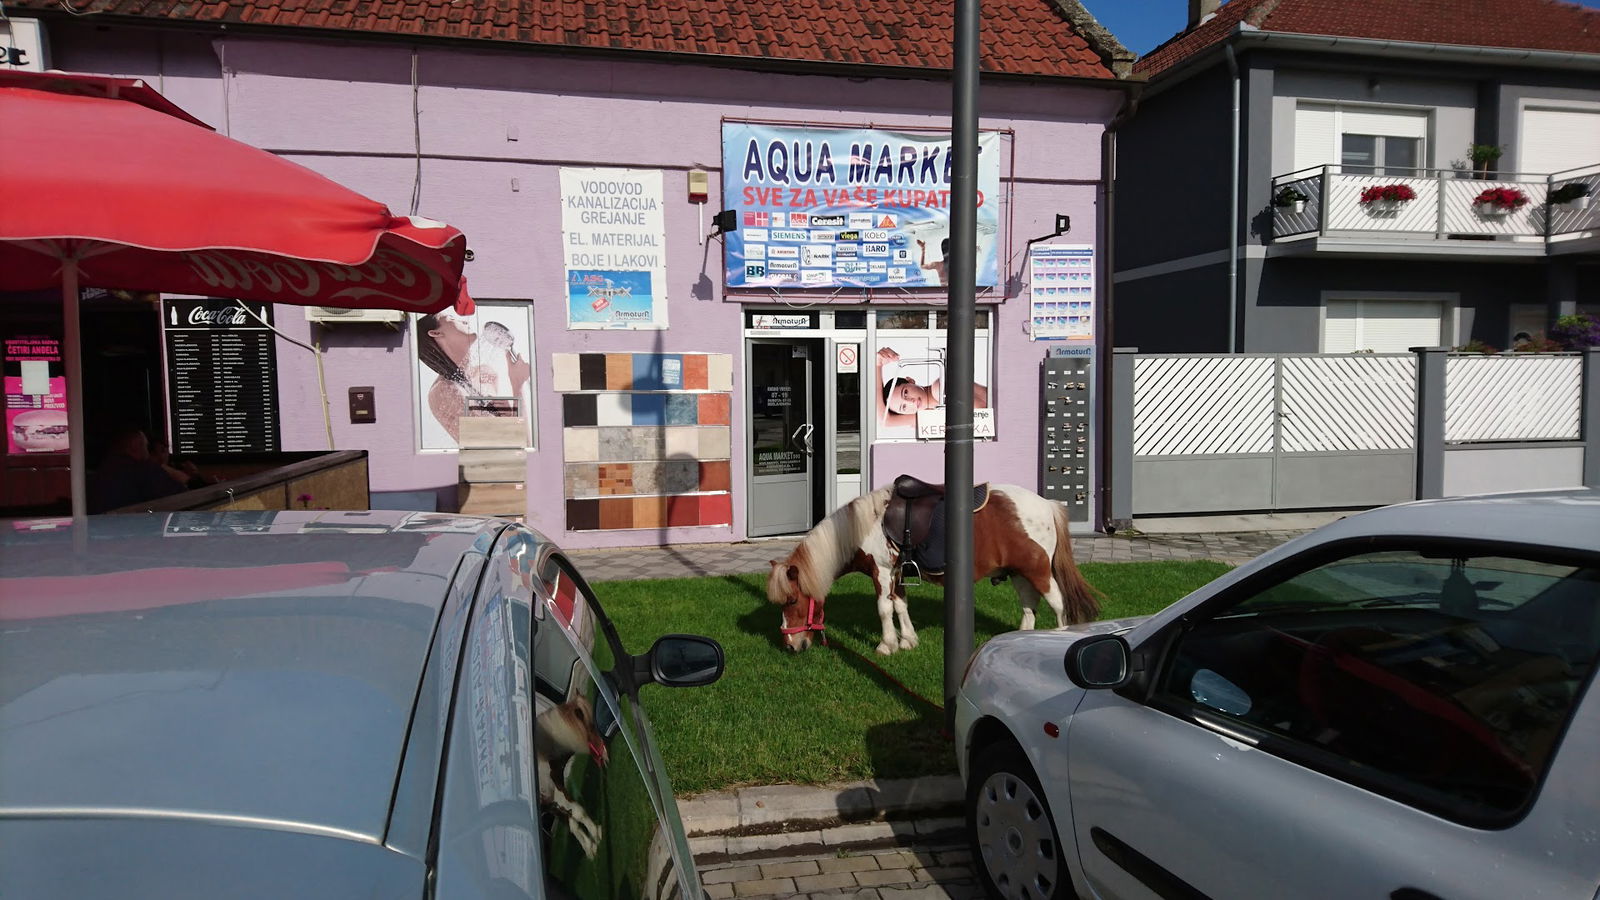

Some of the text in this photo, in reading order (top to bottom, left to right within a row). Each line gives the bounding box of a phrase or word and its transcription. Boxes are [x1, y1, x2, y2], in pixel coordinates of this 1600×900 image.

[743, 138, 836, 185] AQUA
[581, 181, 643, 195] VODOVOD
[568, 196, 657, 210] KANALIZACIJA
[743, 187, 784, 207] SVE
[789, 188, 817, 208] ZA
[823, 186, 879, 208] VAŠE
[581, 211, 646, 225] GREJANJE
[811, 215, 845, 226] Ceresit
[570, 232, 659, 247] EL. MATERIJAL
[772, 231, 806, 240] SIEMENS
[840, 231, 858, 241] viega
[865, 245, 887, 253] HARO
[572, 253, 659, 268] BOJE I LAKOVI
[188, 305, 248, 325] Coca-Cola
[773, 451, 794, 460] MARKET
